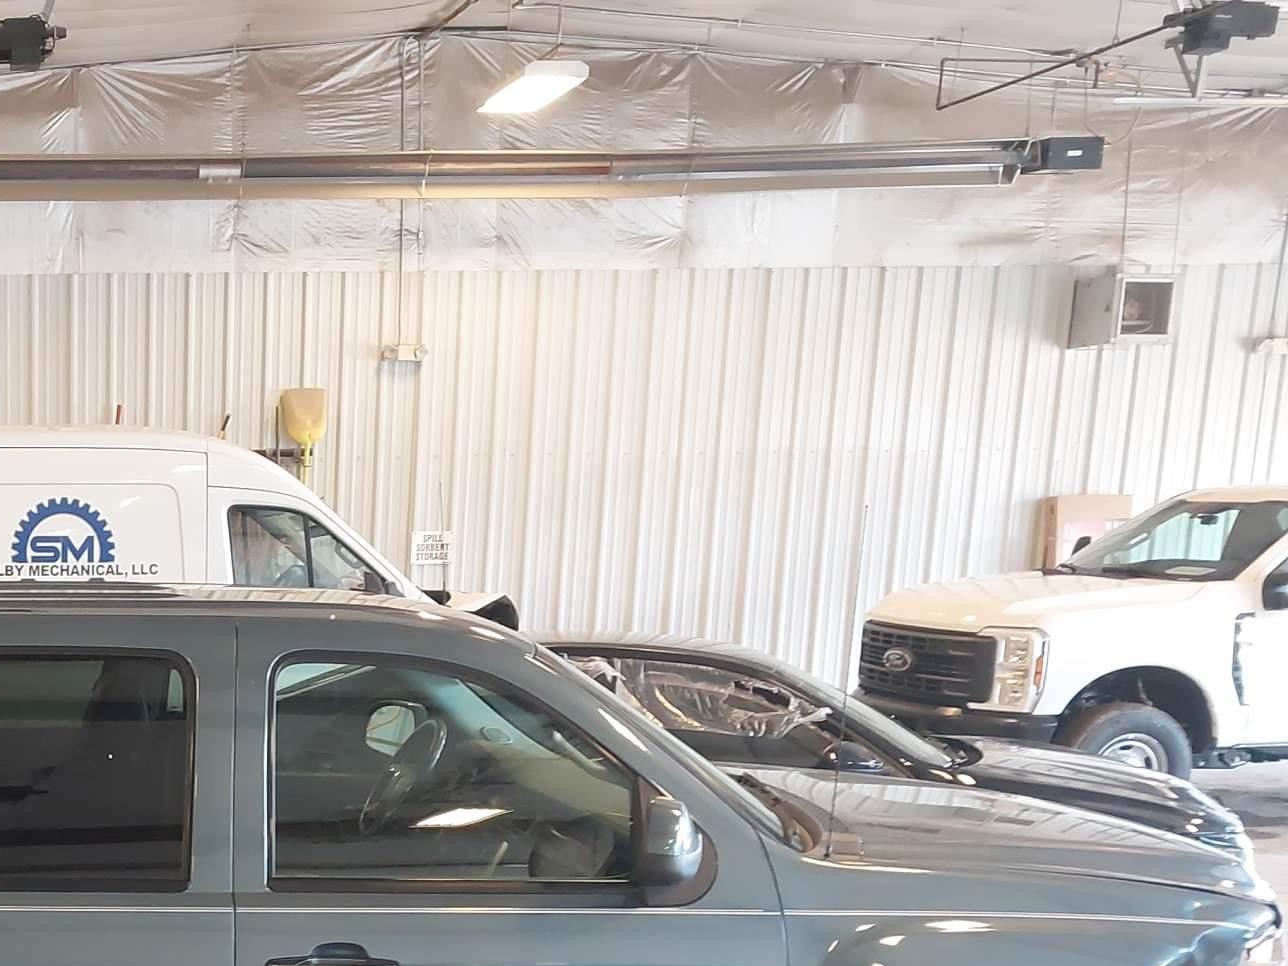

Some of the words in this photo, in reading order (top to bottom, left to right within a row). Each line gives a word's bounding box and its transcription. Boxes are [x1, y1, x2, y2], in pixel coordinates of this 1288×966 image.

[423, 534, 443, 543] SPILL
[30, 535, 94, 563] SM
[416, 552, 449, 560] STORAGE
[28, 563, 129, 577] MECHANICAL,
[132, 563, 159, 575] LLC
